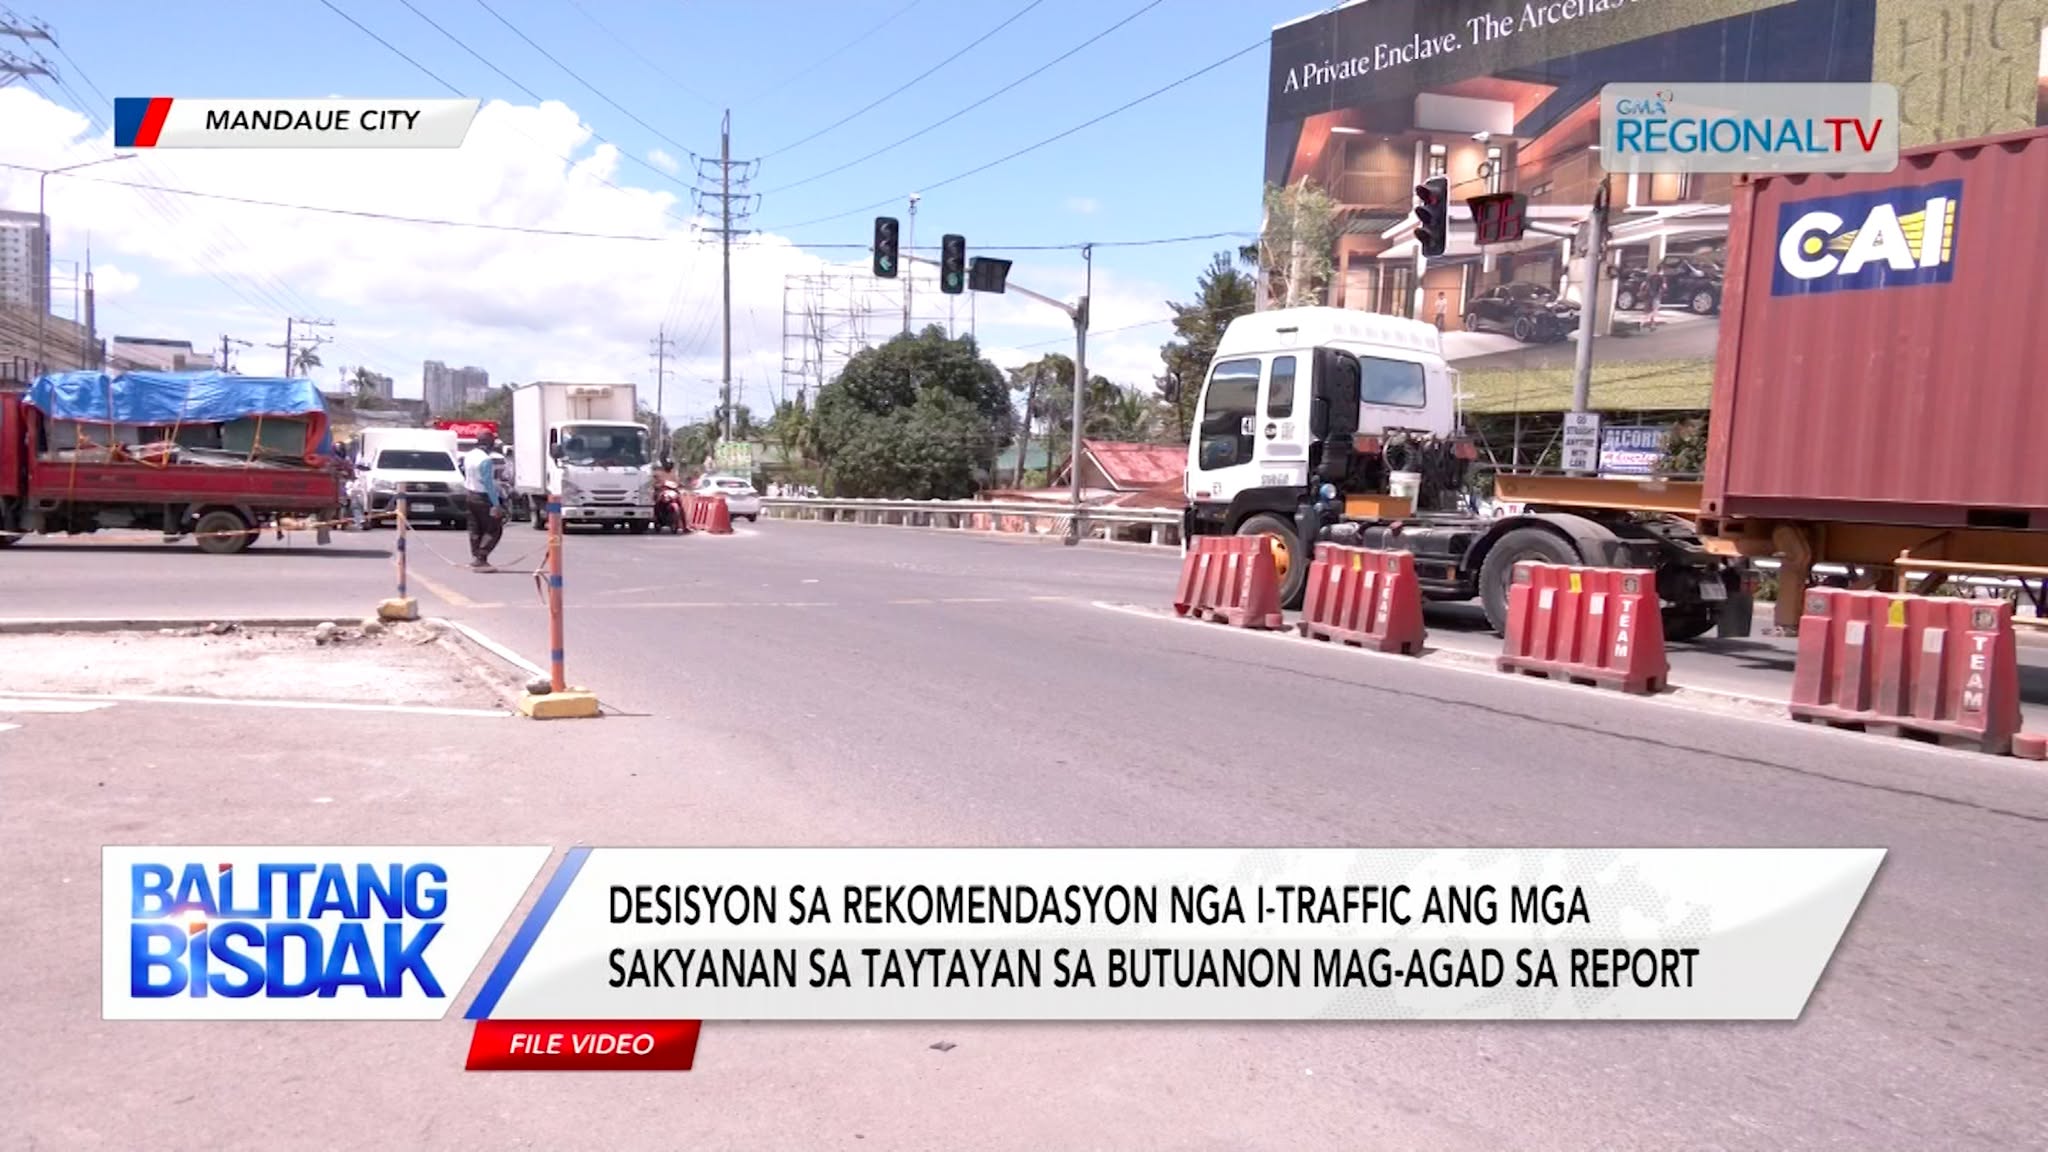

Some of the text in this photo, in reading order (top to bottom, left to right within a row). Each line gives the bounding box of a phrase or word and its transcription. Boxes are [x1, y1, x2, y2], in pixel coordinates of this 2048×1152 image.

[1284, 67, 1299, 93] A
[1303, 55, 1370, 88] Private
[1374, 32, 1462, 71] Enclave.
[1467, 14, 1513, 45] The
[1779, 197, 1948, 279] CAI
[1377, 575, 1393, 623] TEAM
[1614, 600, 1633, 657] TEAM
[1963, 636, 1988, 707] TEAM
